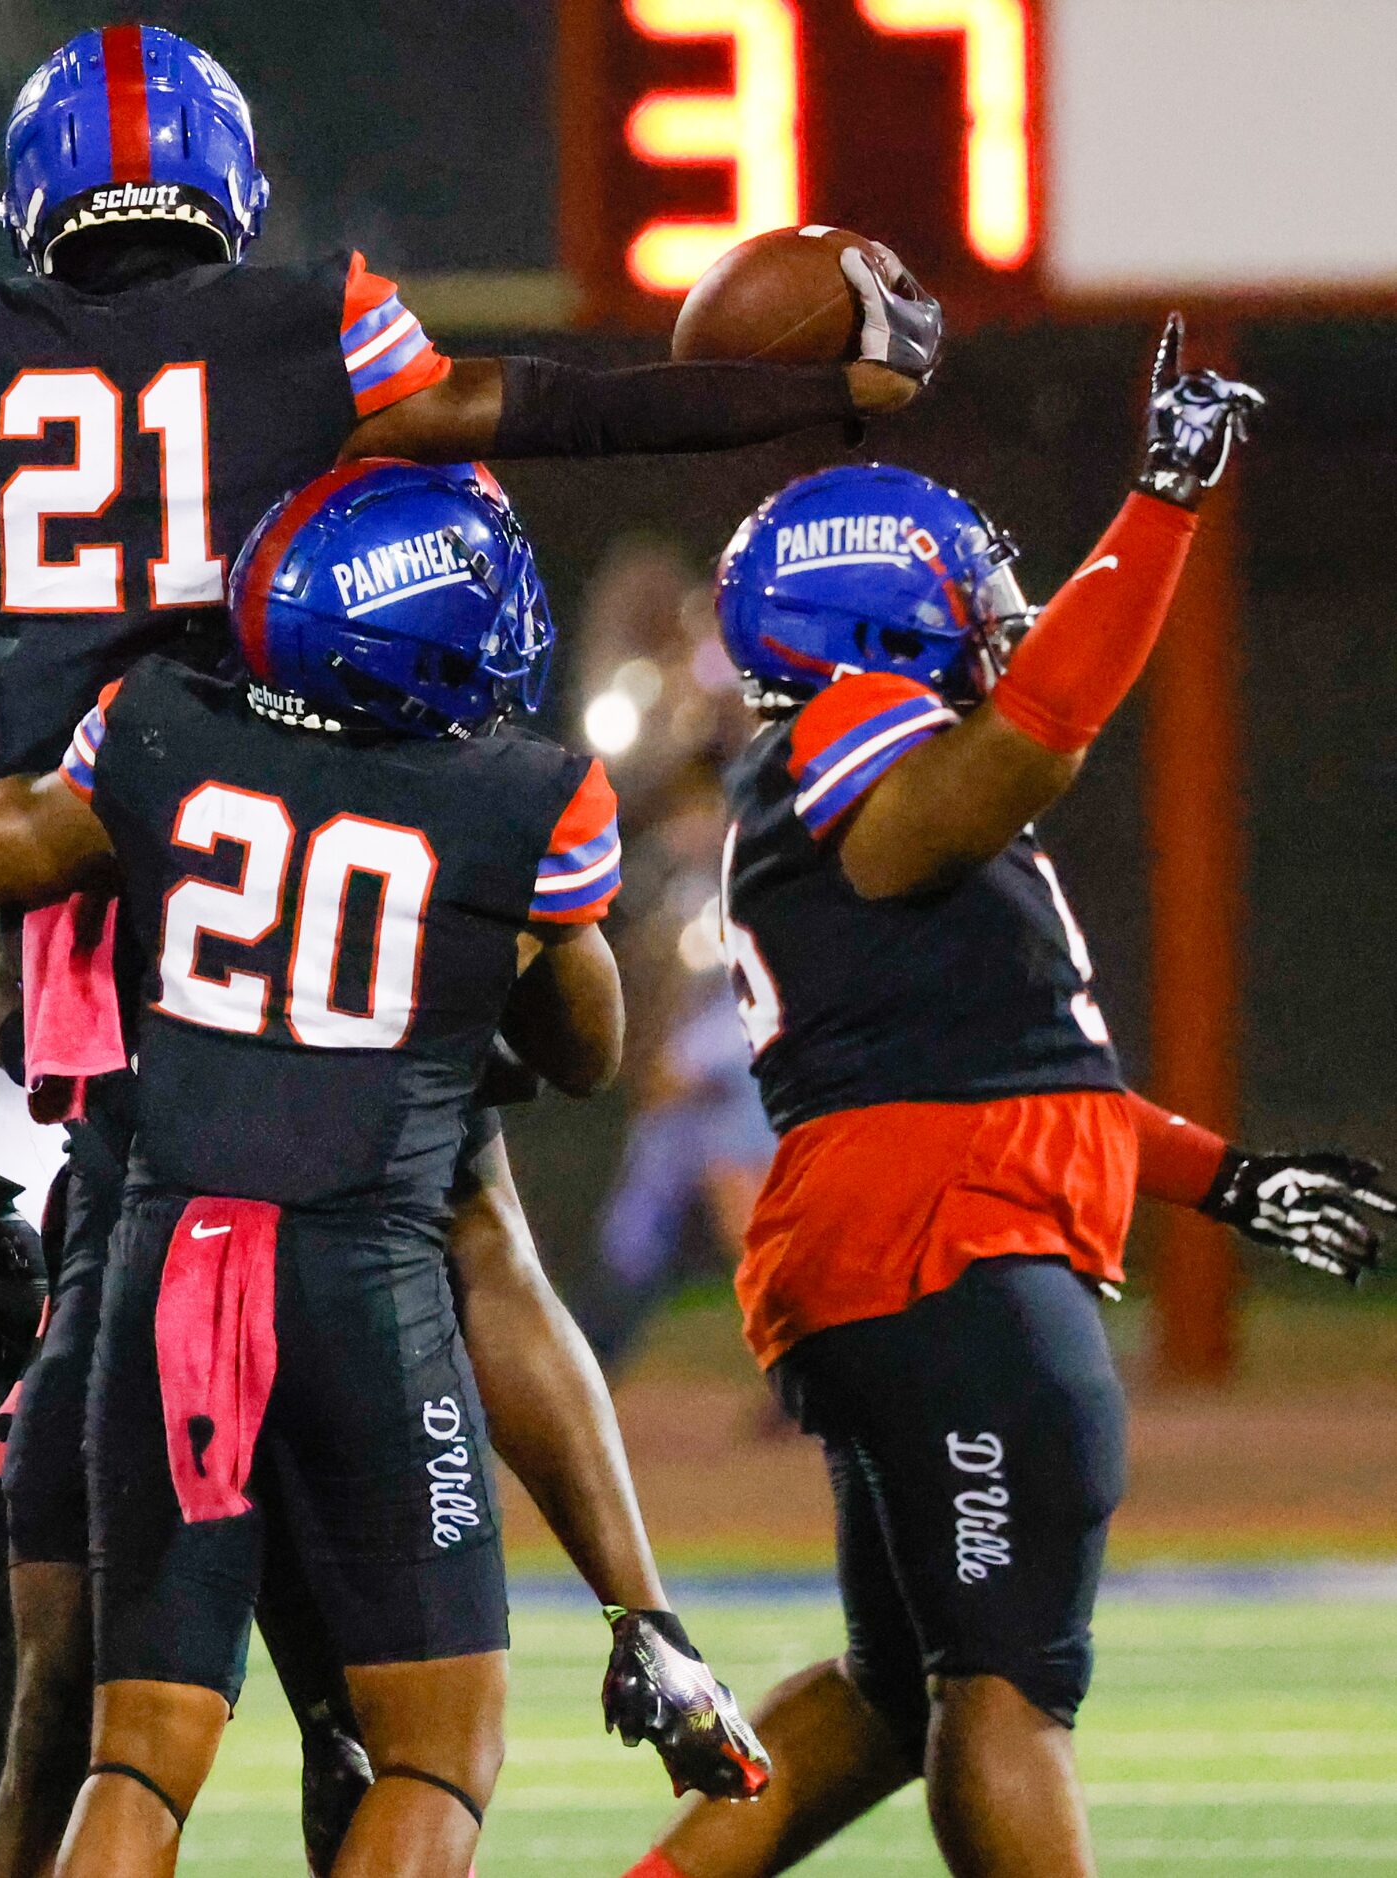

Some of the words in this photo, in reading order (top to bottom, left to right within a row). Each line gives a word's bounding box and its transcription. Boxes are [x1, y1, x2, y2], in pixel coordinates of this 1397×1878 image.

[91, 182, 180, 211] schutt
[625, 0, 1033, 294] 37
[331, 525, 469, 607] PANTHER
[148, 779, 440, 1050] 20
[422, 1395, 480, 1549] D'Ville
[946, 1430, 1011, 1585] D'Ville
